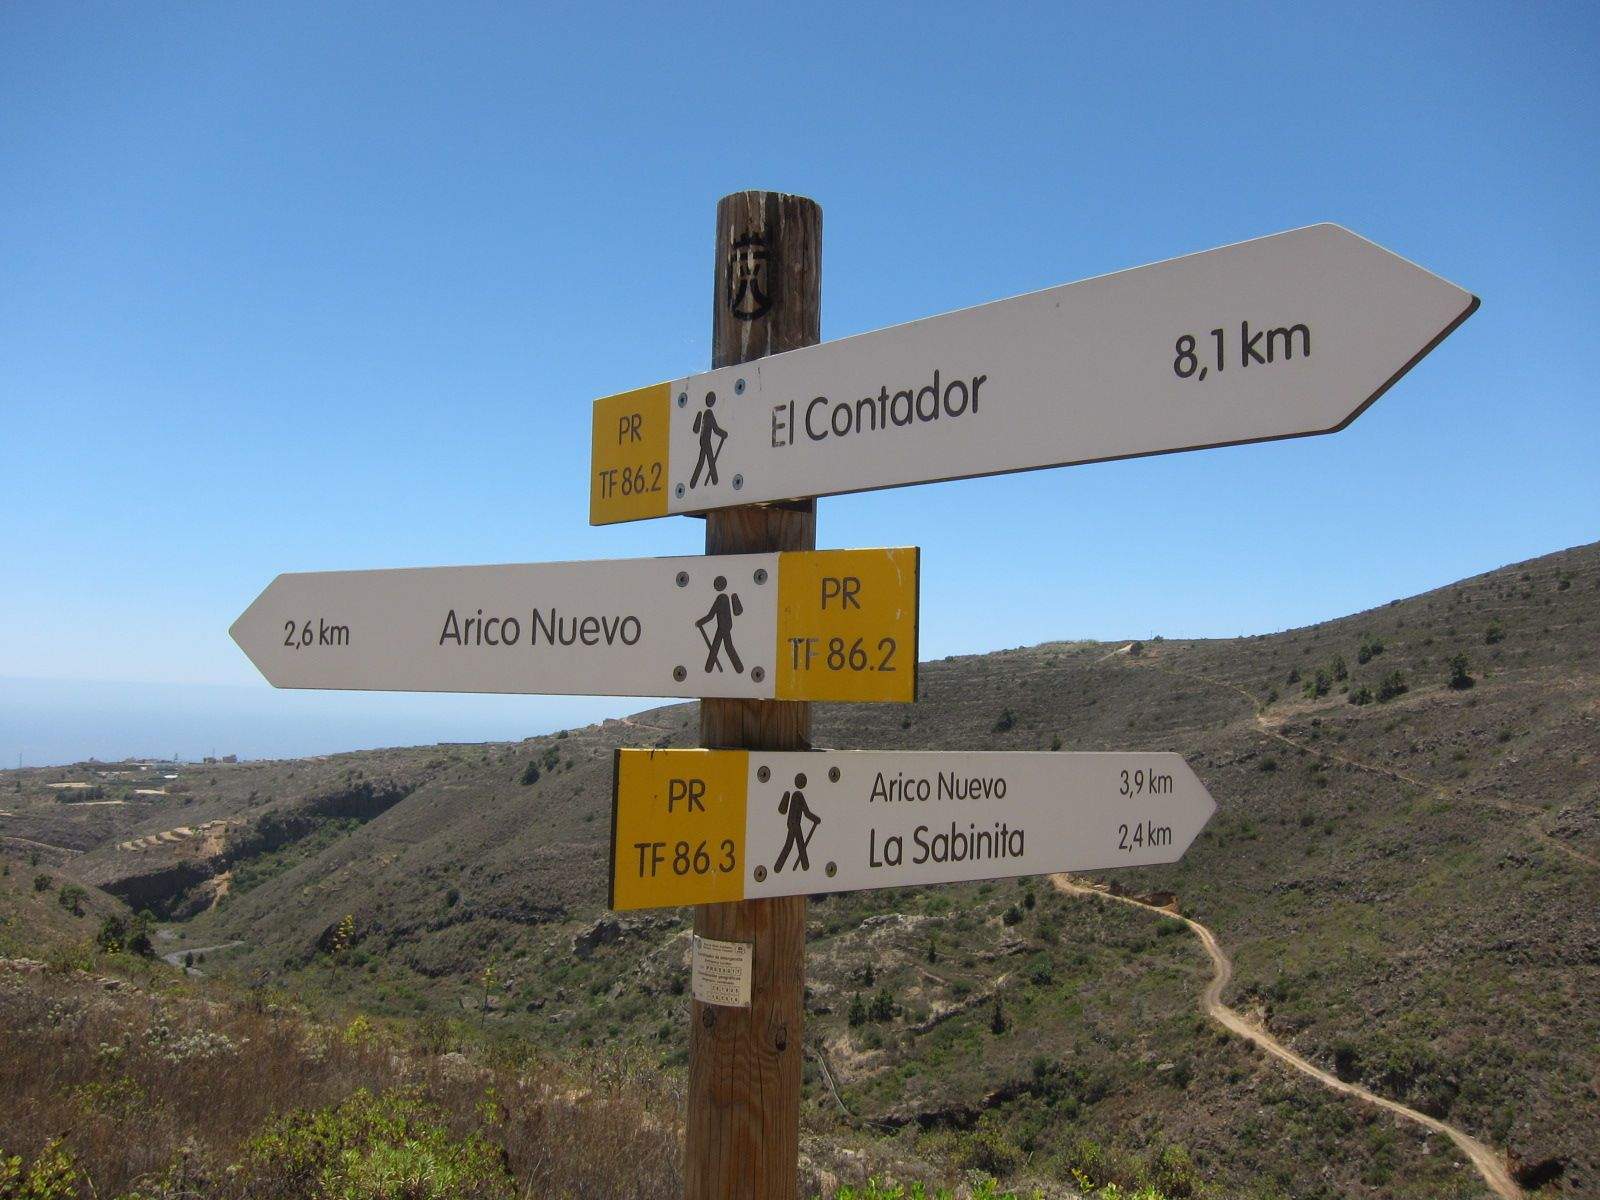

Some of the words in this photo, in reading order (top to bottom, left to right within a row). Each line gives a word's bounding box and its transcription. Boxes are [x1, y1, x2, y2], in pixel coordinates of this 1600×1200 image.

[1173, 328, 1225, 382] 8,1
[1241, 320, 1311, 368] km
[771, 399, 795, 448] El
[805, 369, 988, 442] Contador
[618, 413, 642, 446] PR
[598, 469, 618, 500] TF
[621, 462, 662, 496] 86.2
[821, 576, 861, 610] PR
[283, 620, 314, 650] 2,6
[319, 617, 350, 646] km
[439, 608, 521, 646] Arico
[531, 607, 642, 646] Nuevo
[787, 637, 820, 671] TF
[826, 637, 897, 672] 86.2
[668, 778, 706, 814] PR
[869, 772, 931, 803] Arico
[937, 771, 1007, 801] Nuevo
[1119, 769, 1144, 799] 3,9
[1149, 768, 1173, 795] km
[869, 828, 903, 868] La
[912, 821, 1025, 865] Sabinita
[1118, 822, 1144, 853] 2,4
[1147, 820, 1172, 847] km
[633, 842, 667, 878] TF
